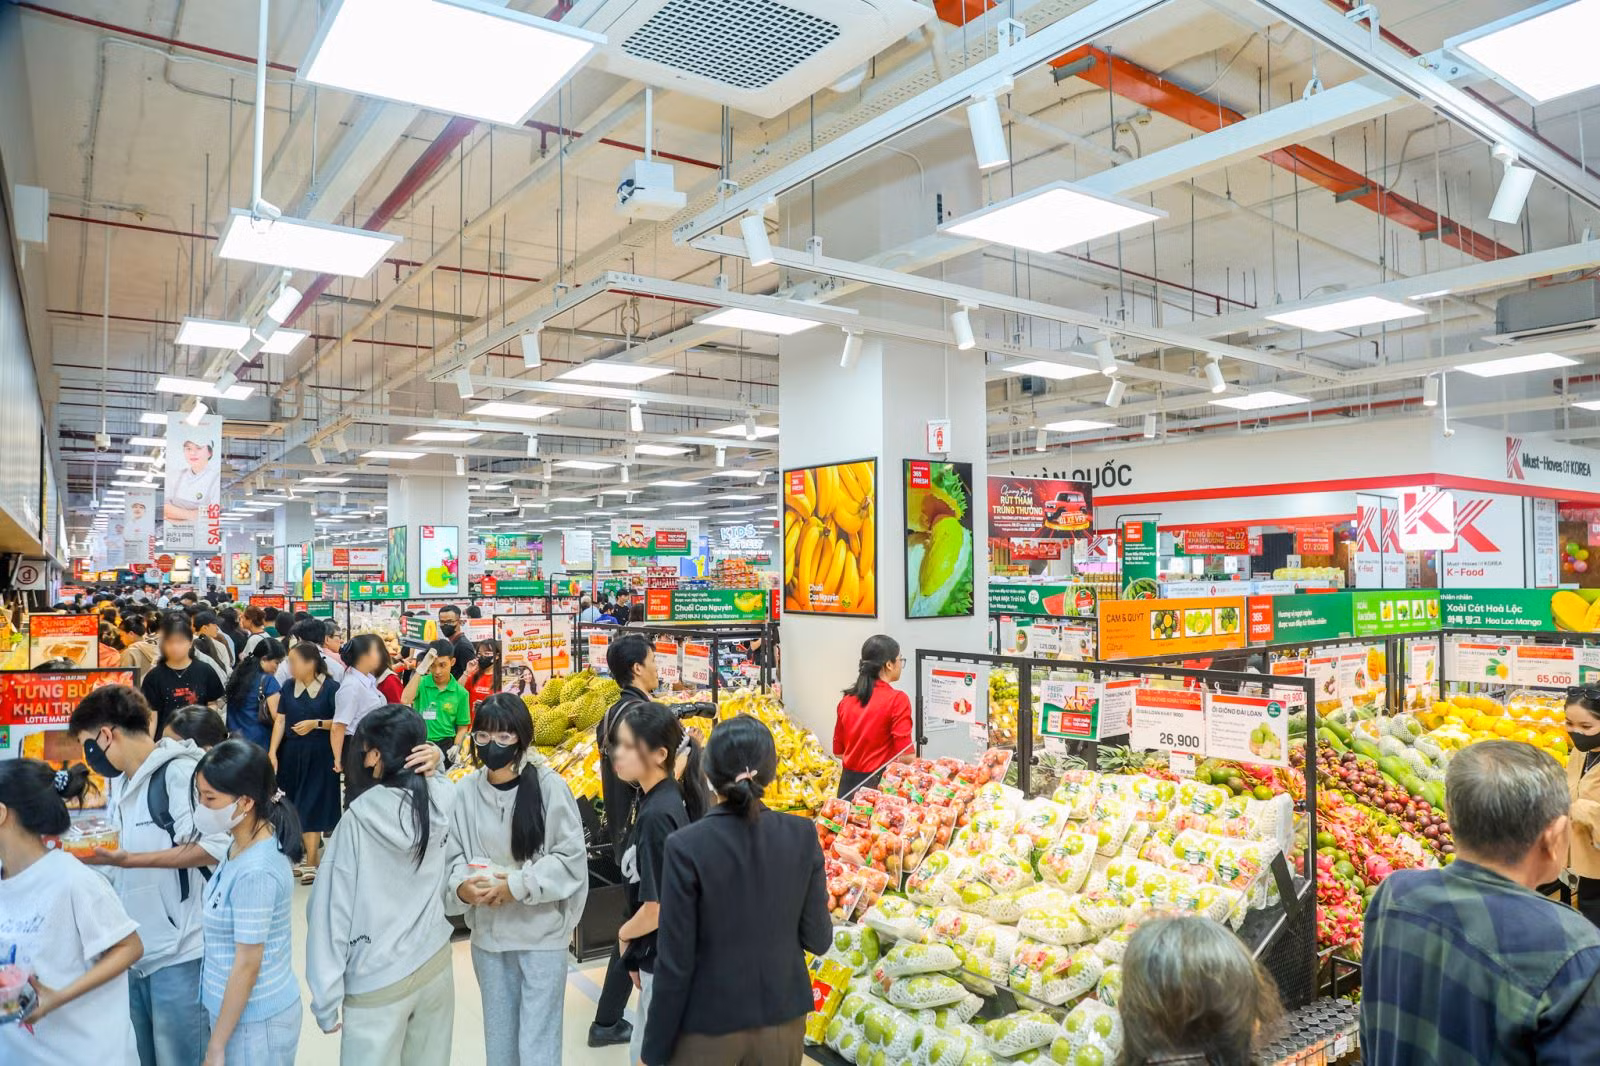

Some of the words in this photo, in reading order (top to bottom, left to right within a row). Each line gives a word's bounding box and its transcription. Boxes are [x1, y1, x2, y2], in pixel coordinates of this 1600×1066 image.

[1570, 461, 1592, 477] KOREA
[992, 504, 1015, 514] TRÚNG
[1404, 491, 1450, 534] K
[207, 503, 220, 545] SALES
[1357, 505, 1381, 552] K
[720, 524, 756, 540] KIDS
[674, 603, 695, 611] Chuối
[1447, 603, 1467, 612] Xoài
[1468, 603, 1484, 612] Cát
[1486, 603, 1504, 613] Hoà
[1505, 603, 1523, 614] Lộc
[1106, 613, 1121, 623] CAM
[1252, 611, 1263, 622] 365
[1515, 617, 1542, 627] Mango
[1252, 623, 1271, 634] FRESH
[1536, 674, 1571, 685] 65,000
[14, 683, 64, 699] TƯNG
[68, 680, 93, 698] BỪ
[13, 703, 49, 716] KHAI
[52, 702, 74, 714] TR
[1246, 709, 1263, 717] LOAN
[25, 716, 48, 724] LOTTE
[49, 715, 70, 723] MART
[1159, 732, 1199, 748] 26,900
